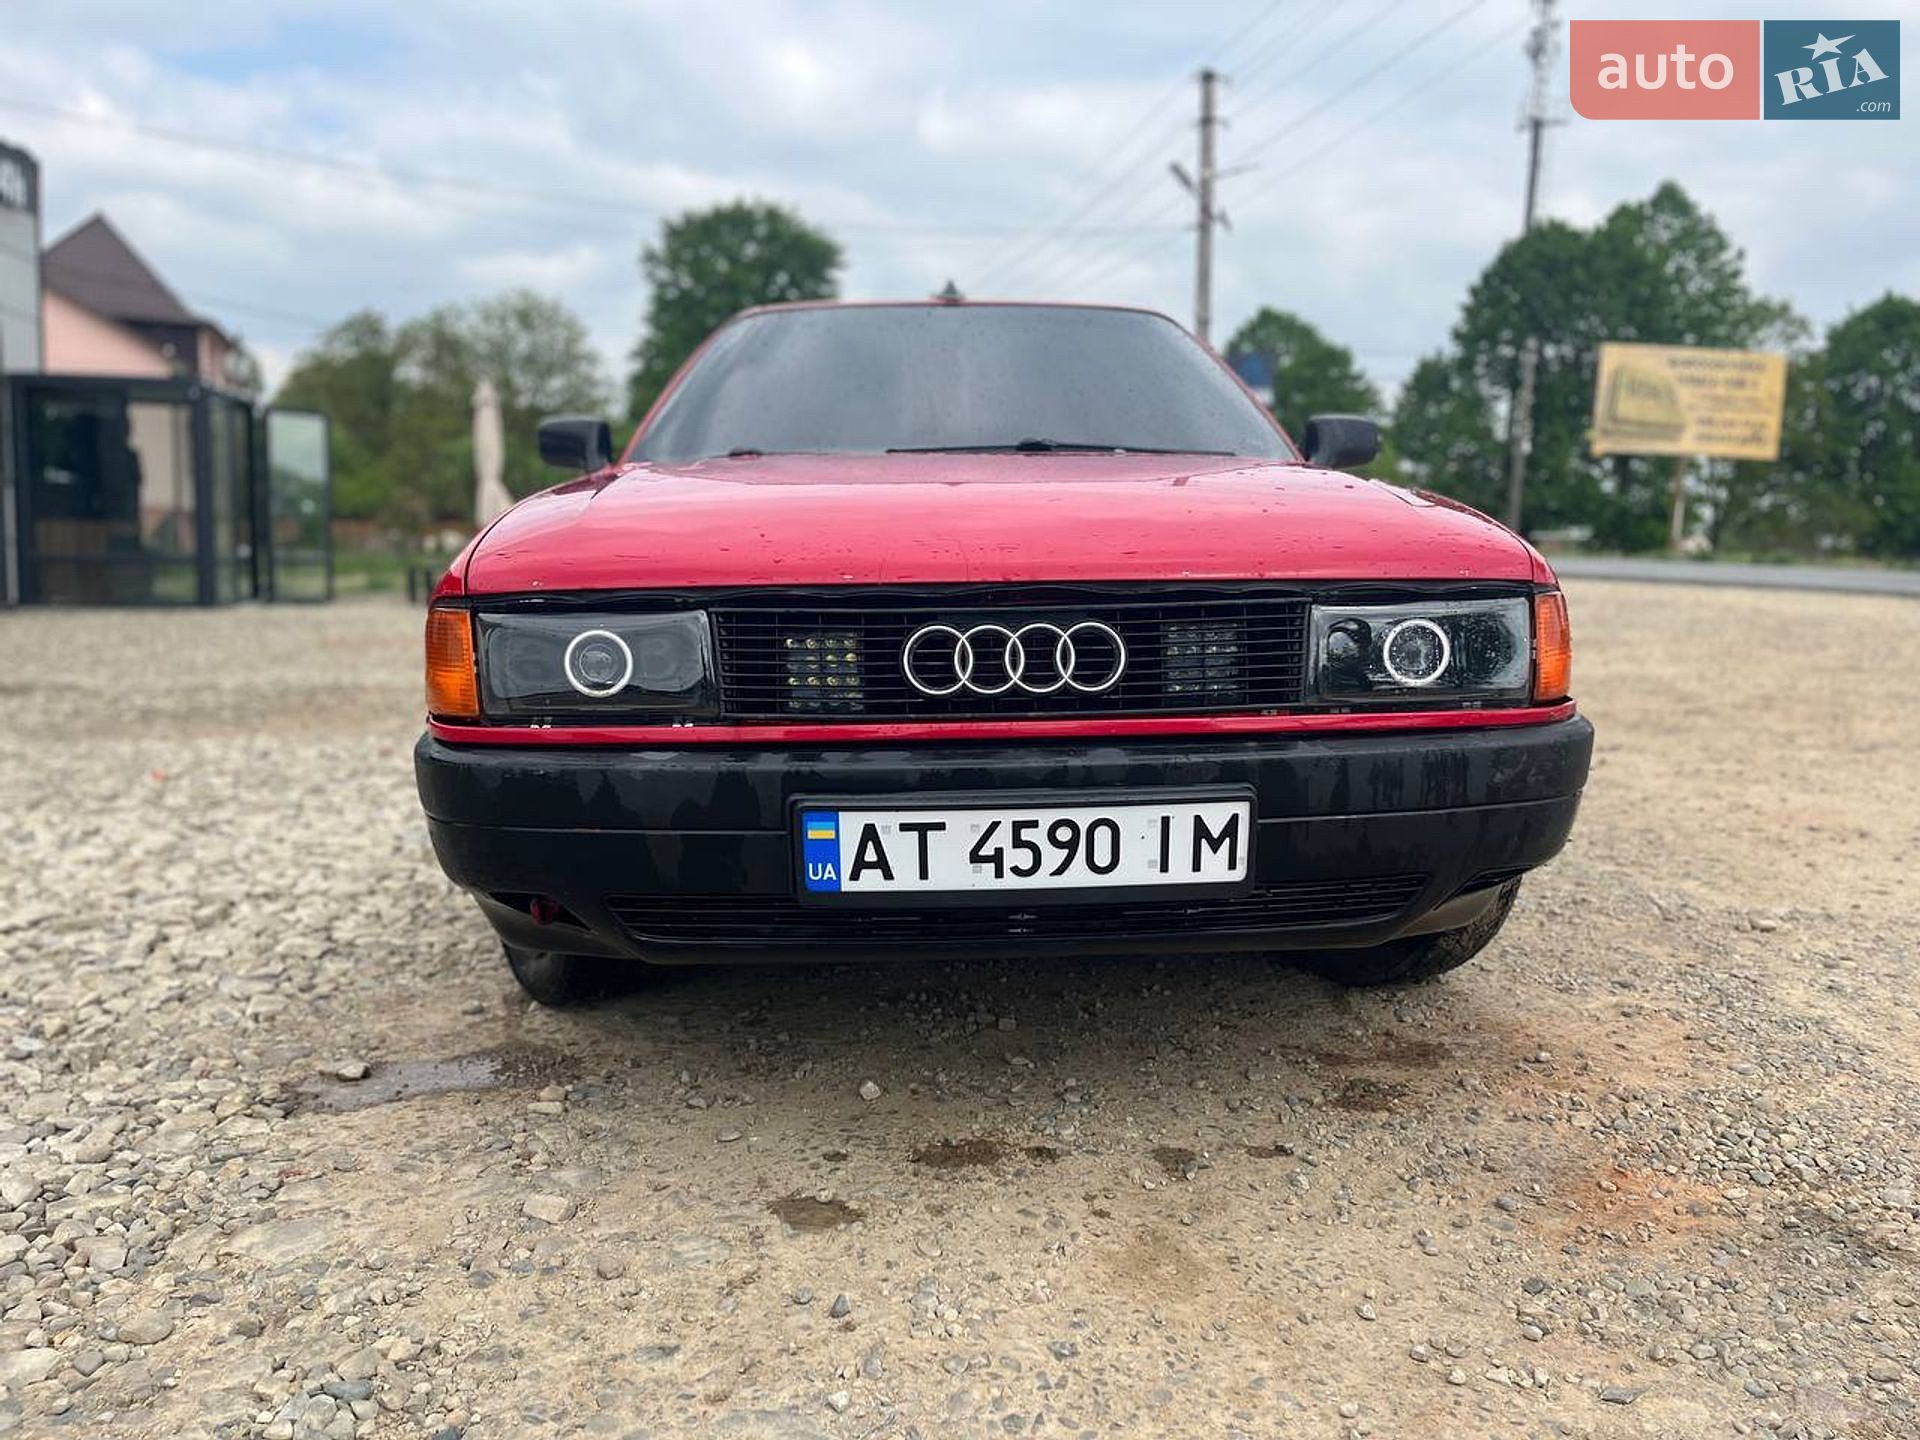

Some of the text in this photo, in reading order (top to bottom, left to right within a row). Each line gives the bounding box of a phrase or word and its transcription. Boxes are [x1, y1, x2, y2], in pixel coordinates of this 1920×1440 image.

[848, 812, 1240, 882] AT 4590 IM
[808, 863, 837, 882] UA
